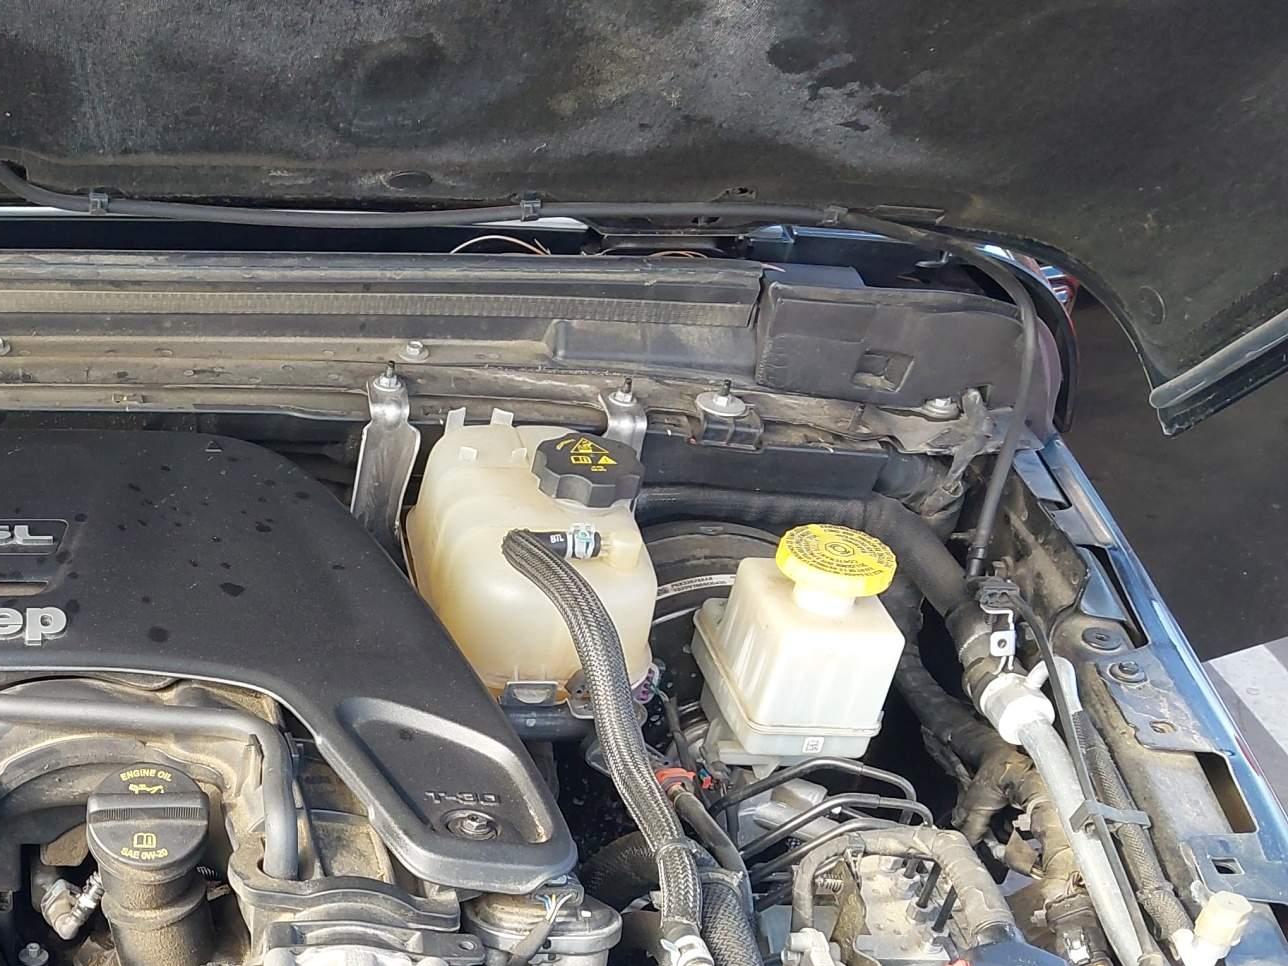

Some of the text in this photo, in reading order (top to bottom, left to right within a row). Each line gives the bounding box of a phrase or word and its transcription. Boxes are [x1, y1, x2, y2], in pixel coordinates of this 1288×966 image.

[119, 768, 173, 782] ENGINE OIL
[423, 790, 502, 806] T-30
[120, 847, 169, 860] SAE 0W-20
